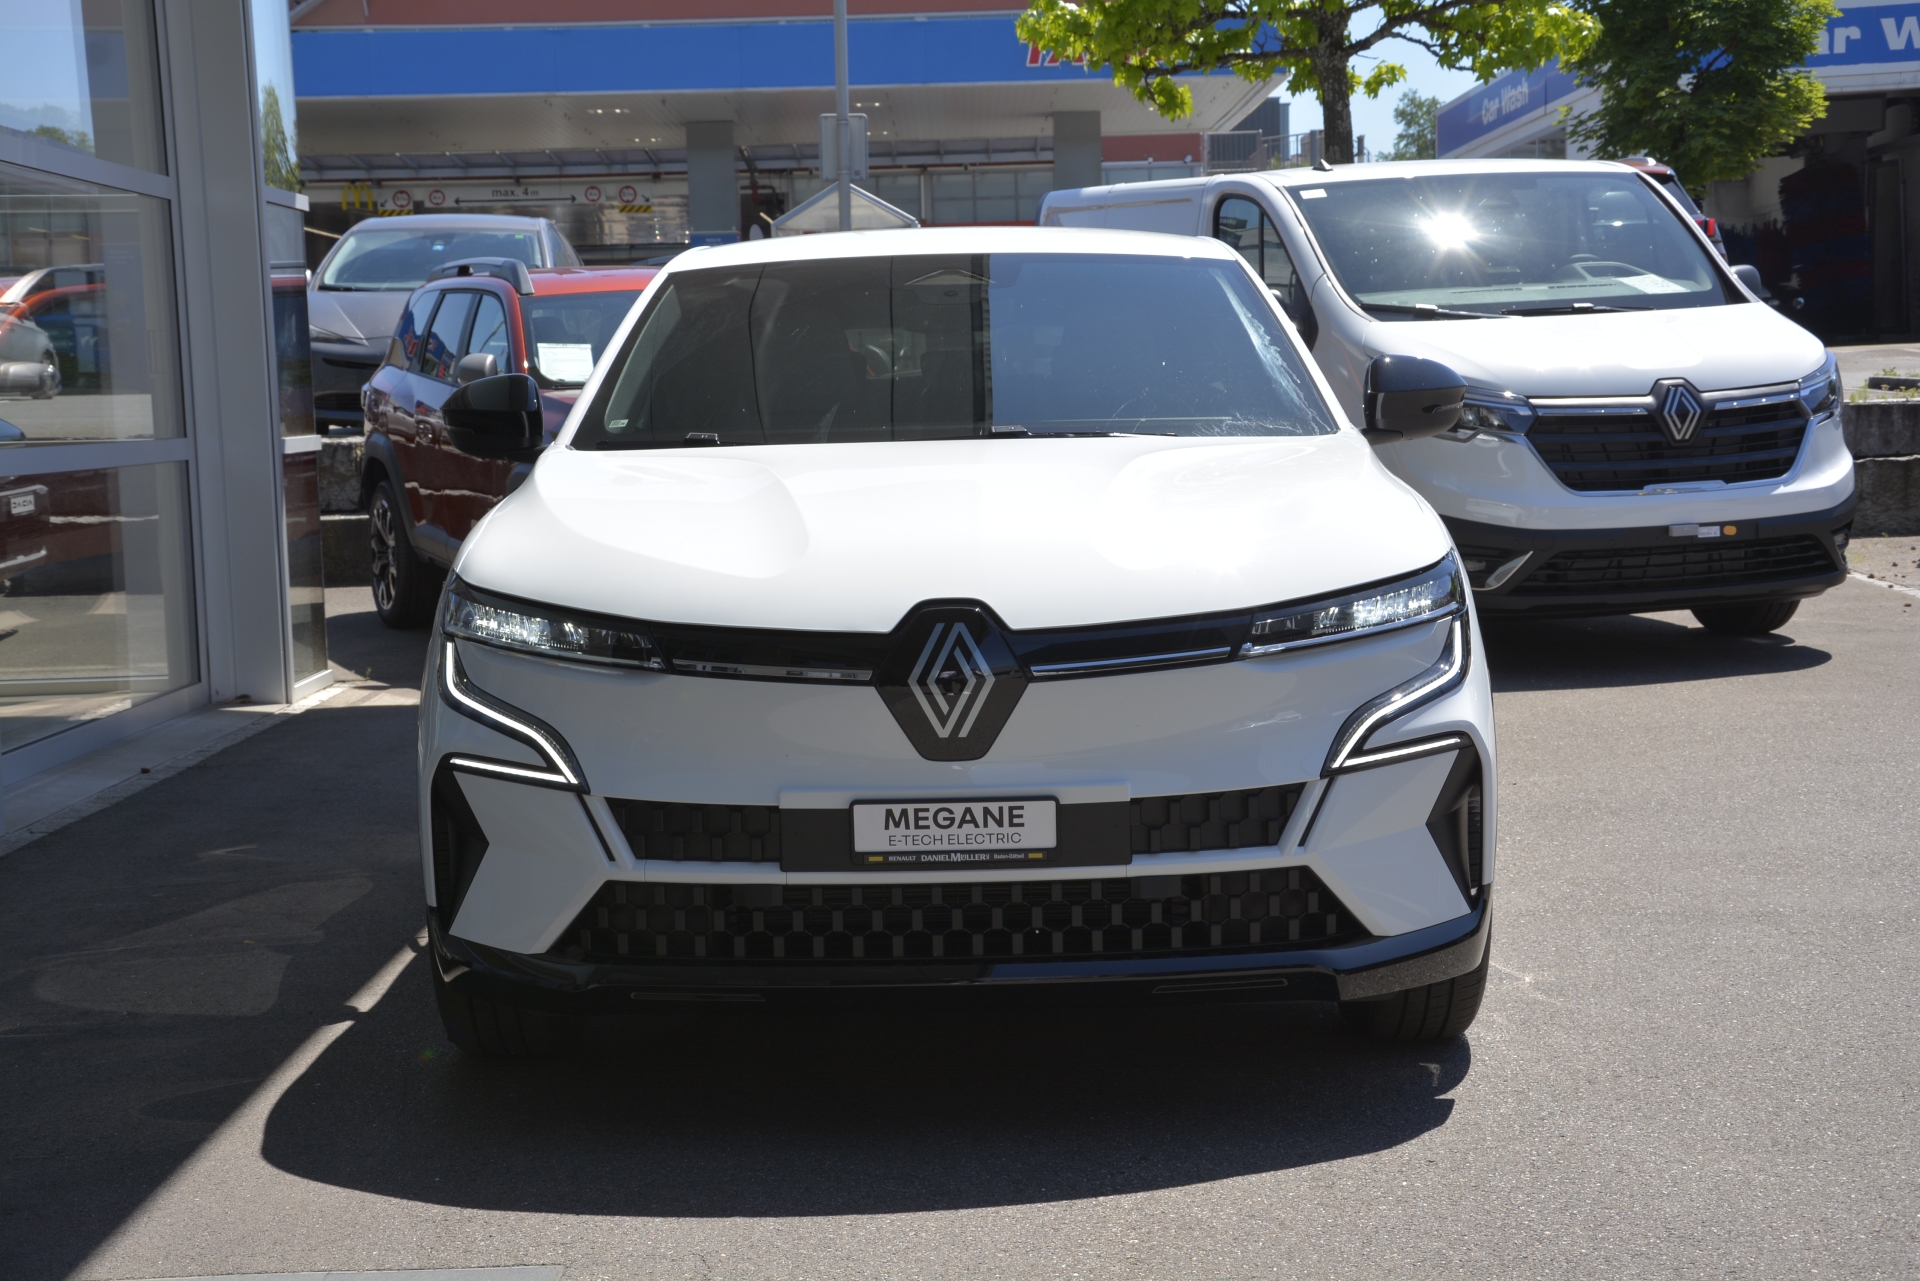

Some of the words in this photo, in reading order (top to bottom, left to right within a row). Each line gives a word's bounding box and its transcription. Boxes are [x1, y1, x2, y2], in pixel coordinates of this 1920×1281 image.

[1481, 97, 1500, 126] Car
[1501, 77, 1529, 116] Wash
[491, 188, 519, 198] max.
[884, 805, 1025, 831] MEGANE
[888, 834, 943, 846] E-TECH
[947, 832, 1022, 846] ELECTRIC
